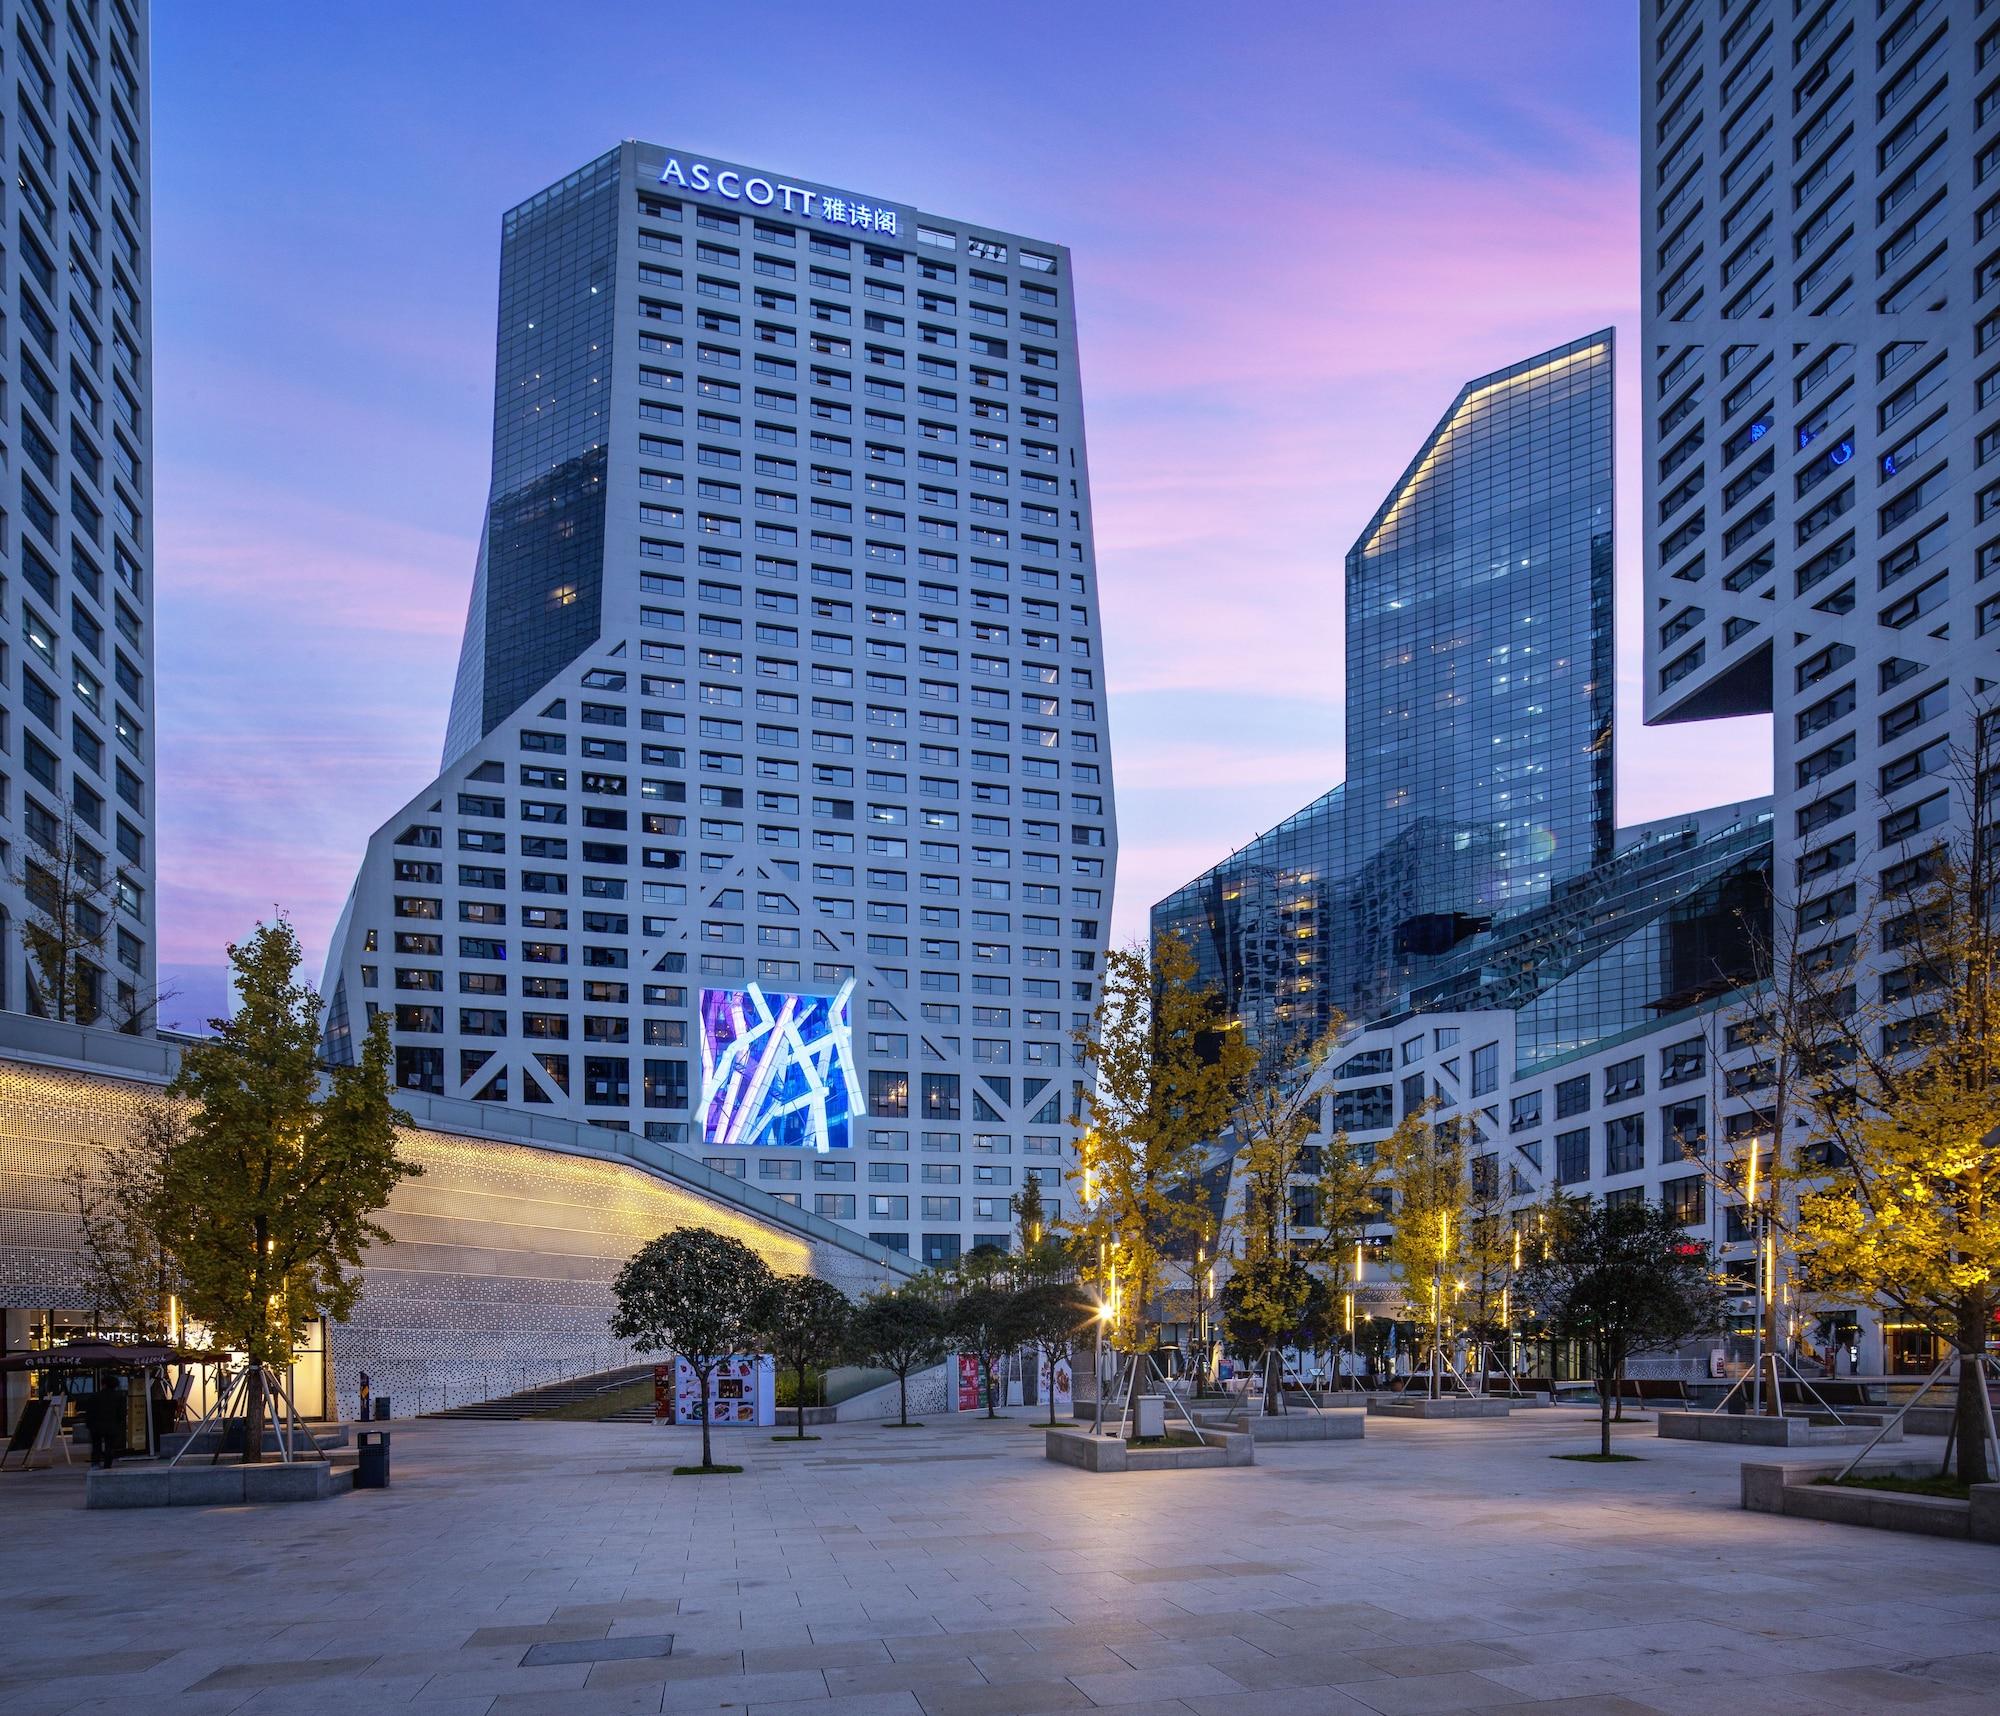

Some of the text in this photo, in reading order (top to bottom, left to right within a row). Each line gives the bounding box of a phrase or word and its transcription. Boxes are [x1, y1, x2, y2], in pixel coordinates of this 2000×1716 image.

[659, 158, 898, 237] ASCOTT 雅诗阁
